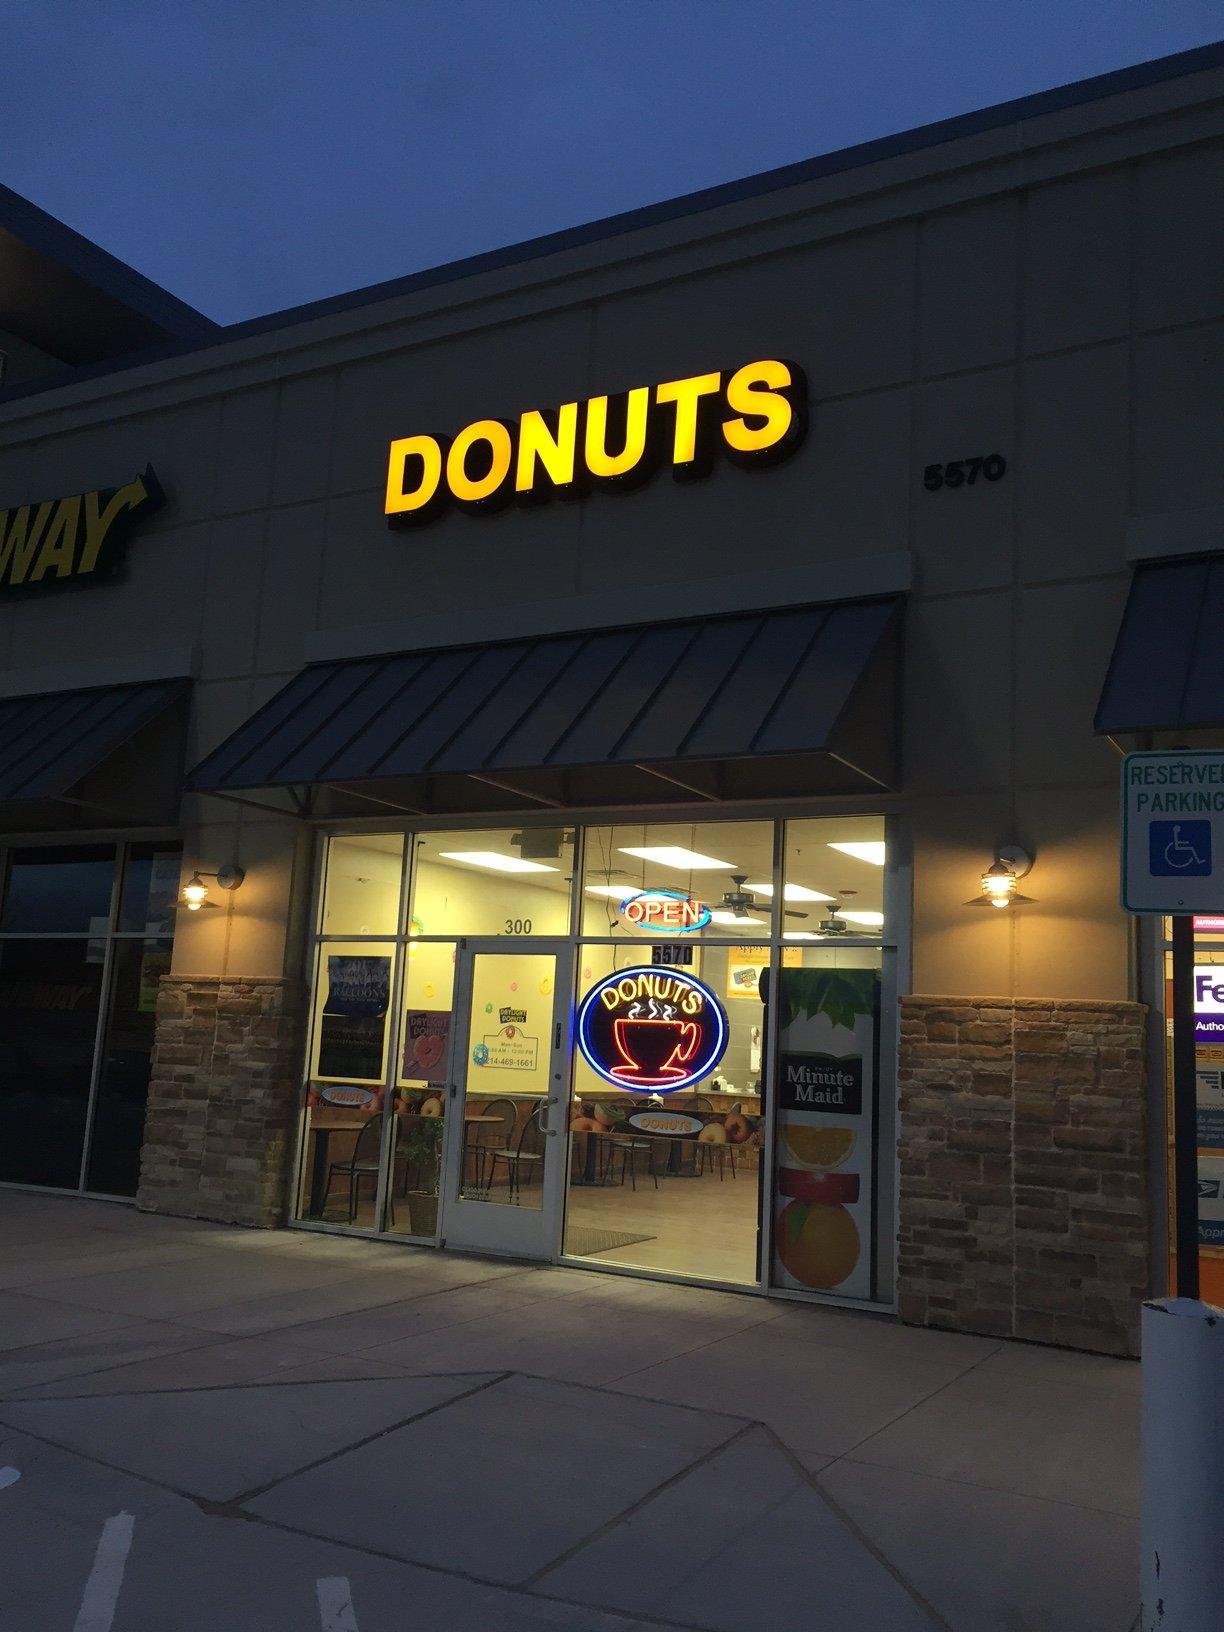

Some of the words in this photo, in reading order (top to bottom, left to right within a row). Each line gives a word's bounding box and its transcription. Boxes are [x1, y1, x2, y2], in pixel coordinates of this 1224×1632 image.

[384, 359, 794, 516] DONUTS
[924, 454, 1007, 491] 5570
[1137, 792, 1224, 812] PARKING
[624, 899, 701, 924] OPEN
[505, 919, 532, 935] 300
[652, 946, 693, 965] 5570
[600, 973, 702, 1015] DONUTS
[785, 1065, 854, 1087] Minute
[793, 1083, 844, 1105] Maid
[639, 1116, 694, 1132] DONUTS
